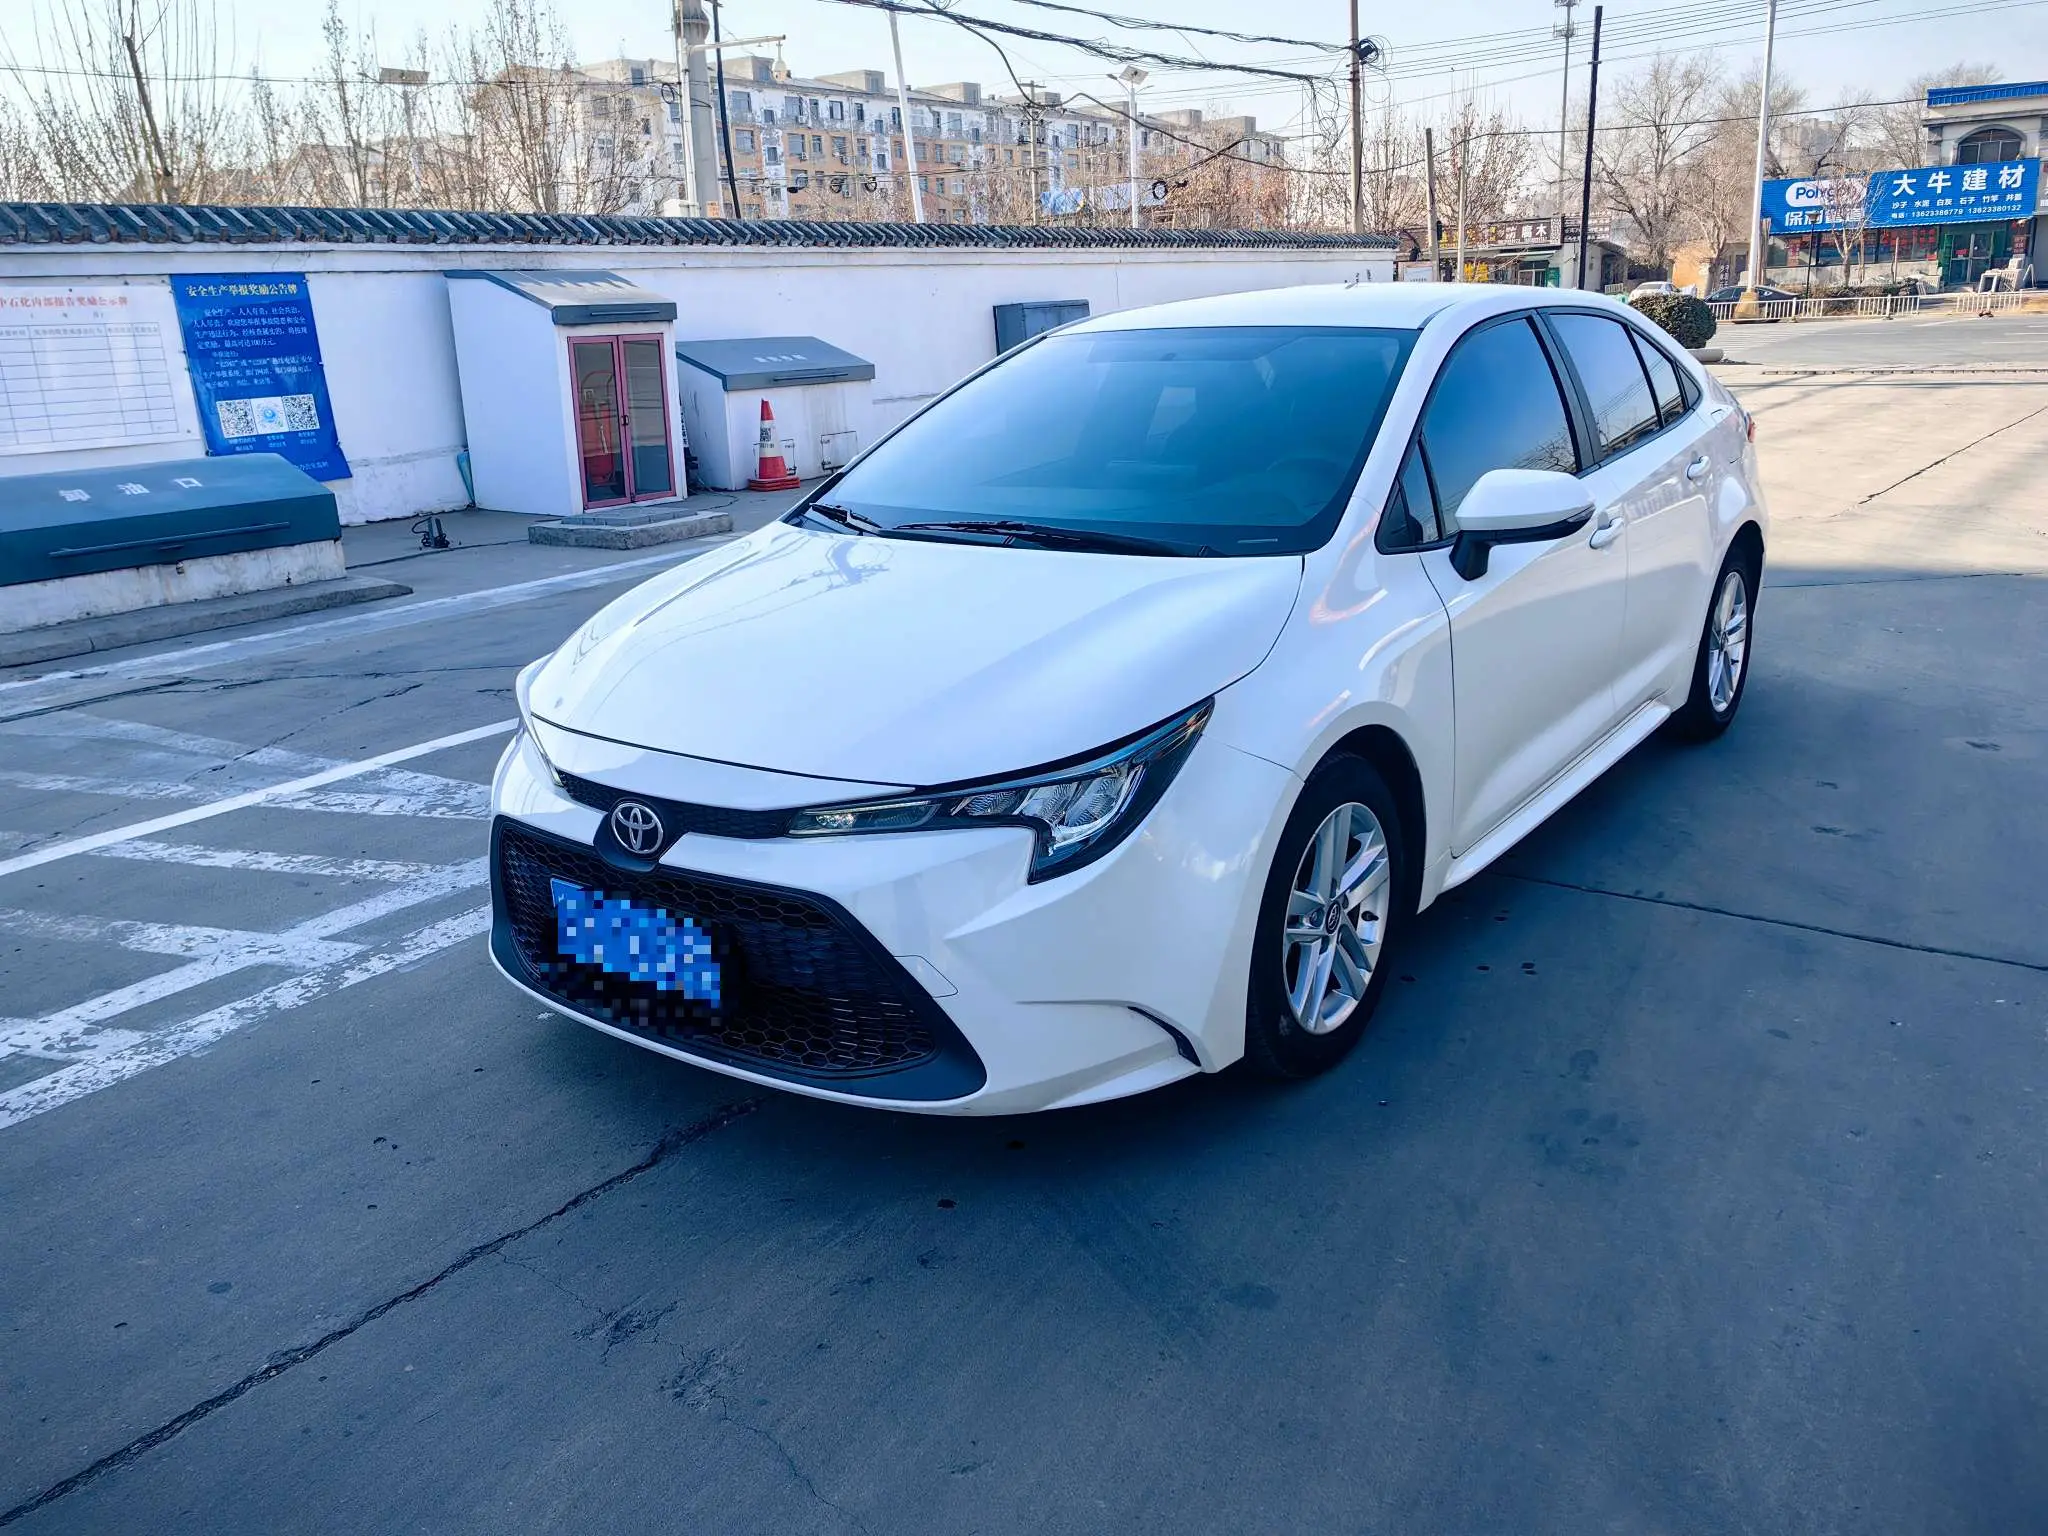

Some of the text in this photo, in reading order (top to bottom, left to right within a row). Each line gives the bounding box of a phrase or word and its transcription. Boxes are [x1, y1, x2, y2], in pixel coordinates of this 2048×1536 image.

[1892, 164, 2026, 197] 大牛建材
[1891, 201, 1908, 209] 沙子
[1914, 199, 1930, 208] 水泥
[1936, 198, 1953, 206] 白灰
[1959, 196, 1976, 205] 石子
